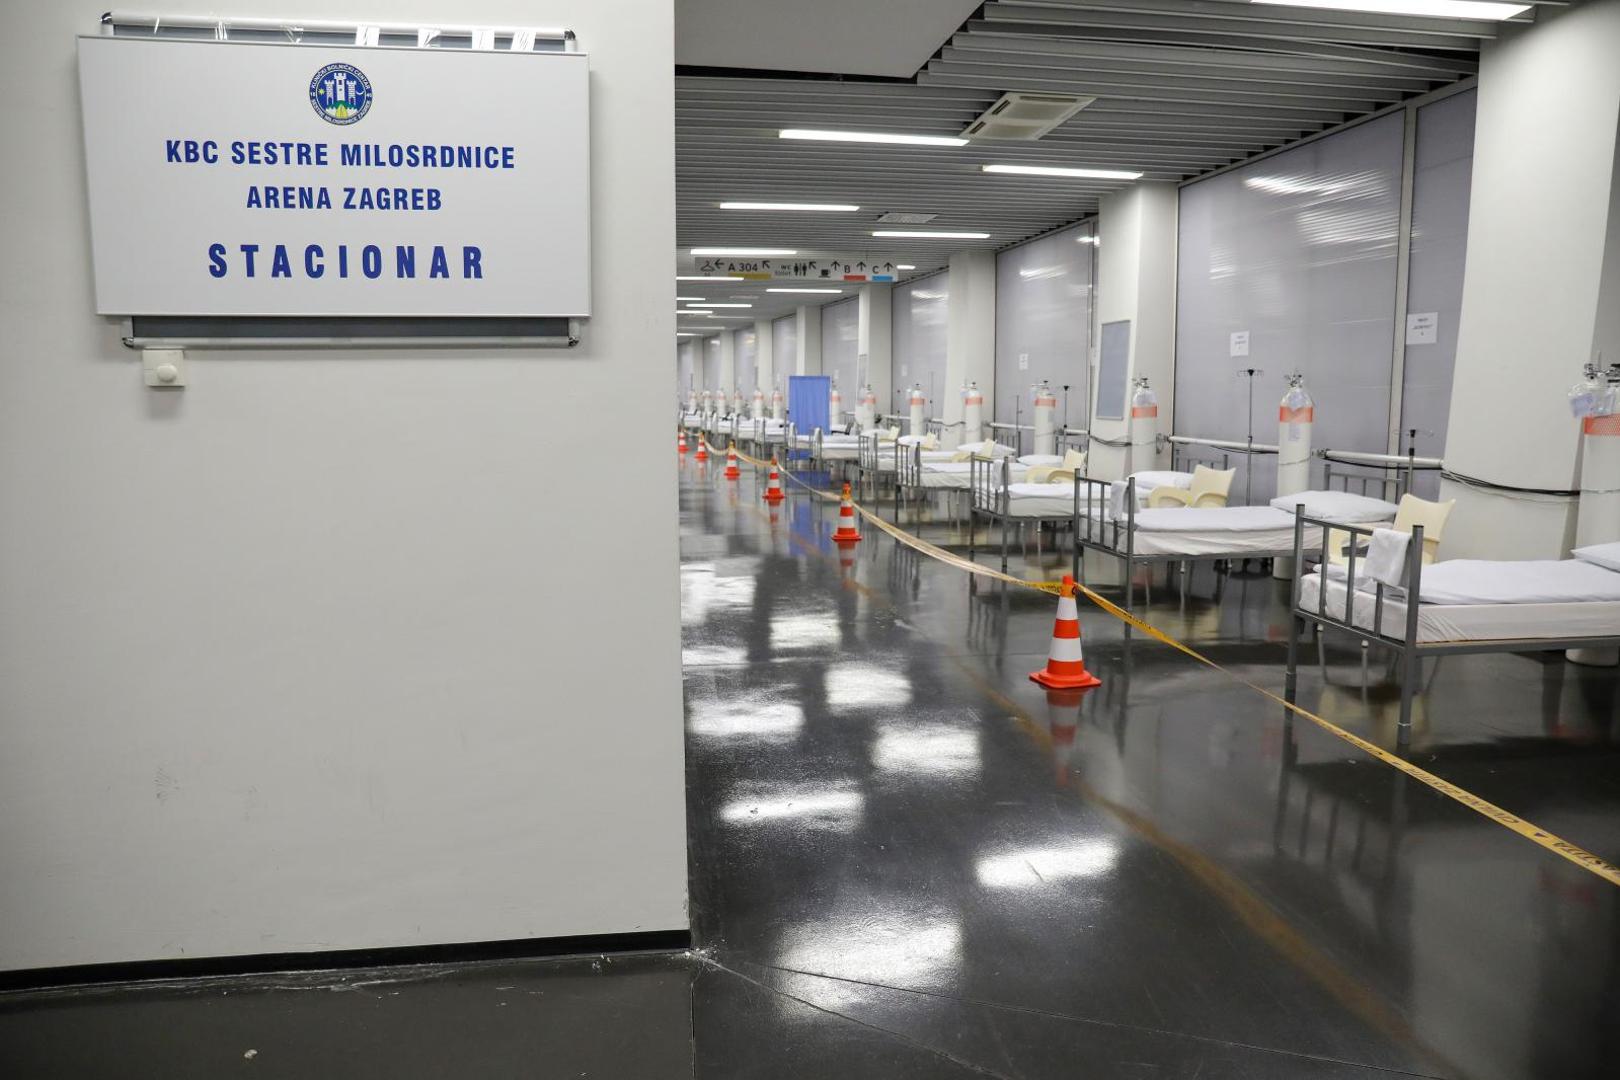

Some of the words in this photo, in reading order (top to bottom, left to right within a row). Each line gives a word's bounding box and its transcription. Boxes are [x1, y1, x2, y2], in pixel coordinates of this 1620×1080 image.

[166, 140, 219, 164] KBC
[231, 142, 328, 167] SESTRE
[341, 144, 515, 169] MILOSRDNICE
[247, 186, 333, 210] ARENA
[344, 188, 443, 212] ZAGREB
[209, 244, 484, 279] STACIONAR
[728, 263, 735, 272] A
[739, 263, 758, 272] 304
[844, 265, 851, 274] B
[872, 265, 880, 274] C
